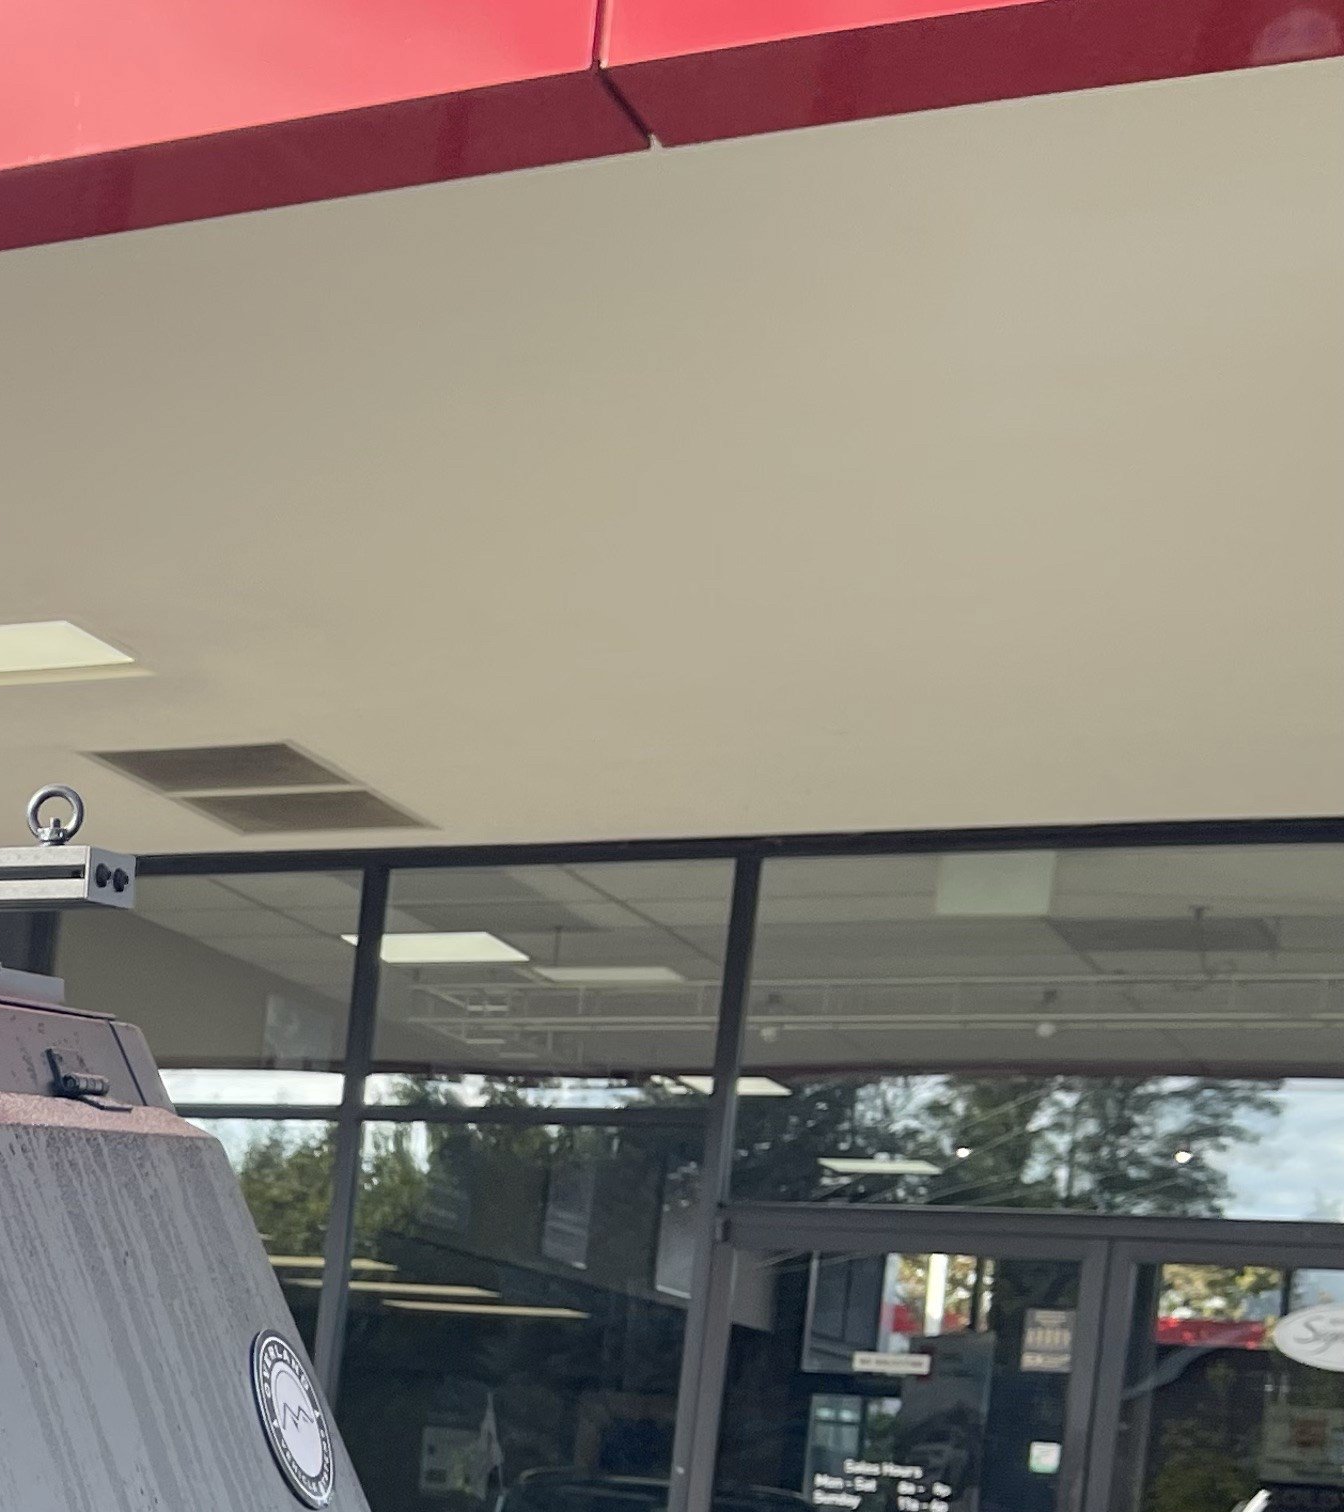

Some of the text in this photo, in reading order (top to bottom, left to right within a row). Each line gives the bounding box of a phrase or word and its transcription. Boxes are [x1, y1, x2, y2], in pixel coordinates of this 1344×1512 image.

[263, 1344, 309, 1398] OVERLAND
[843, 1459, 923, 1479] Sales Hours
[814, 1473, 844, 1490] Mon
[853, 1476, 877, 1492] Sat
[813, 1489, 861, 1510] Sunday
